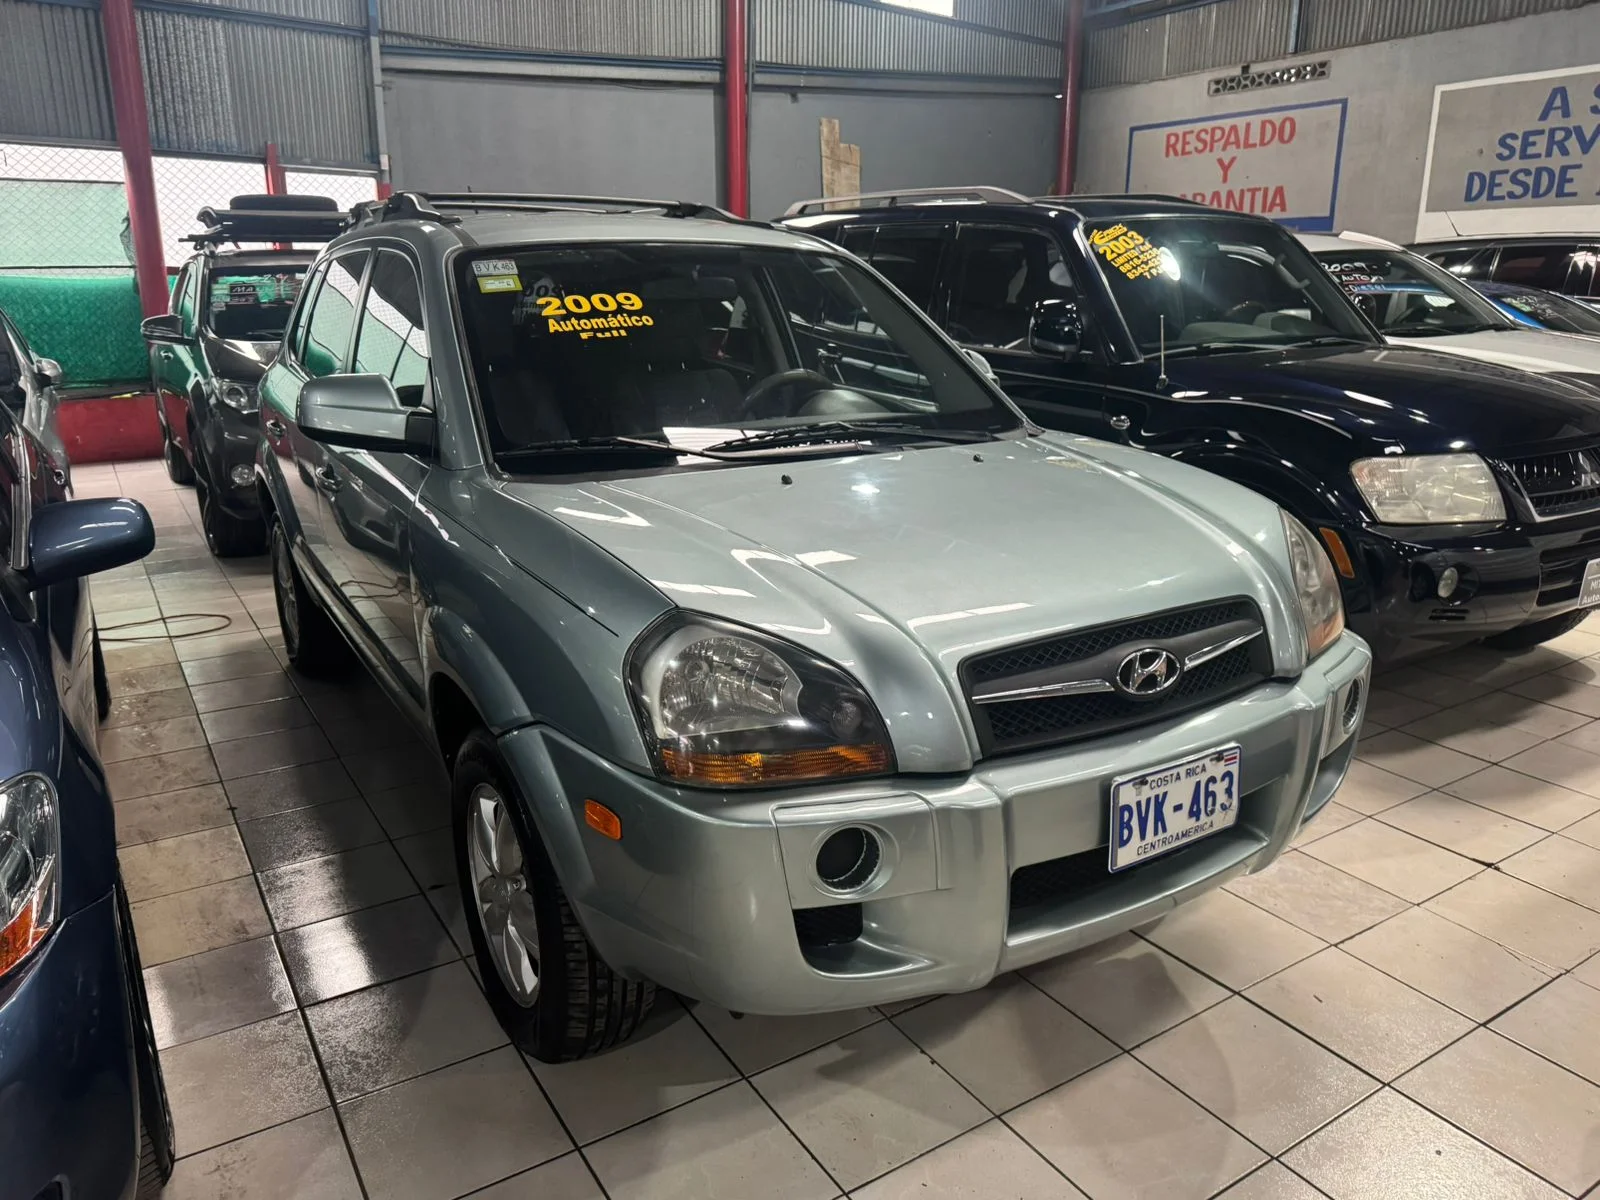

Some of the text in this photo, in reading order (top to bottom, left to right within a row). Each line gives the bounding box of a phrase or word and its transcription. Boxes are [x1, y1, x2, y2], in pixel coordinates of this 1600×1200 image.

[1537, 86, 1571, 121] A
[1165, 116, 1296, 158] RESPALDO
[1216, 156, 1237, 184] Y
[1464, 163, 1583, 202] DESDE
[1098, 230, 1145, 261] 2003
[536, 292, 644, 316] 2009
[548, 313, 654, 333] Automático
[579, 329, 628, 340] Full
[1149, 763, 1207, 790] COSTA RICA
[1118, 770, 1235, 849] BVK-463
[1136, 820, 1214, 856] CENTROAMERICA
